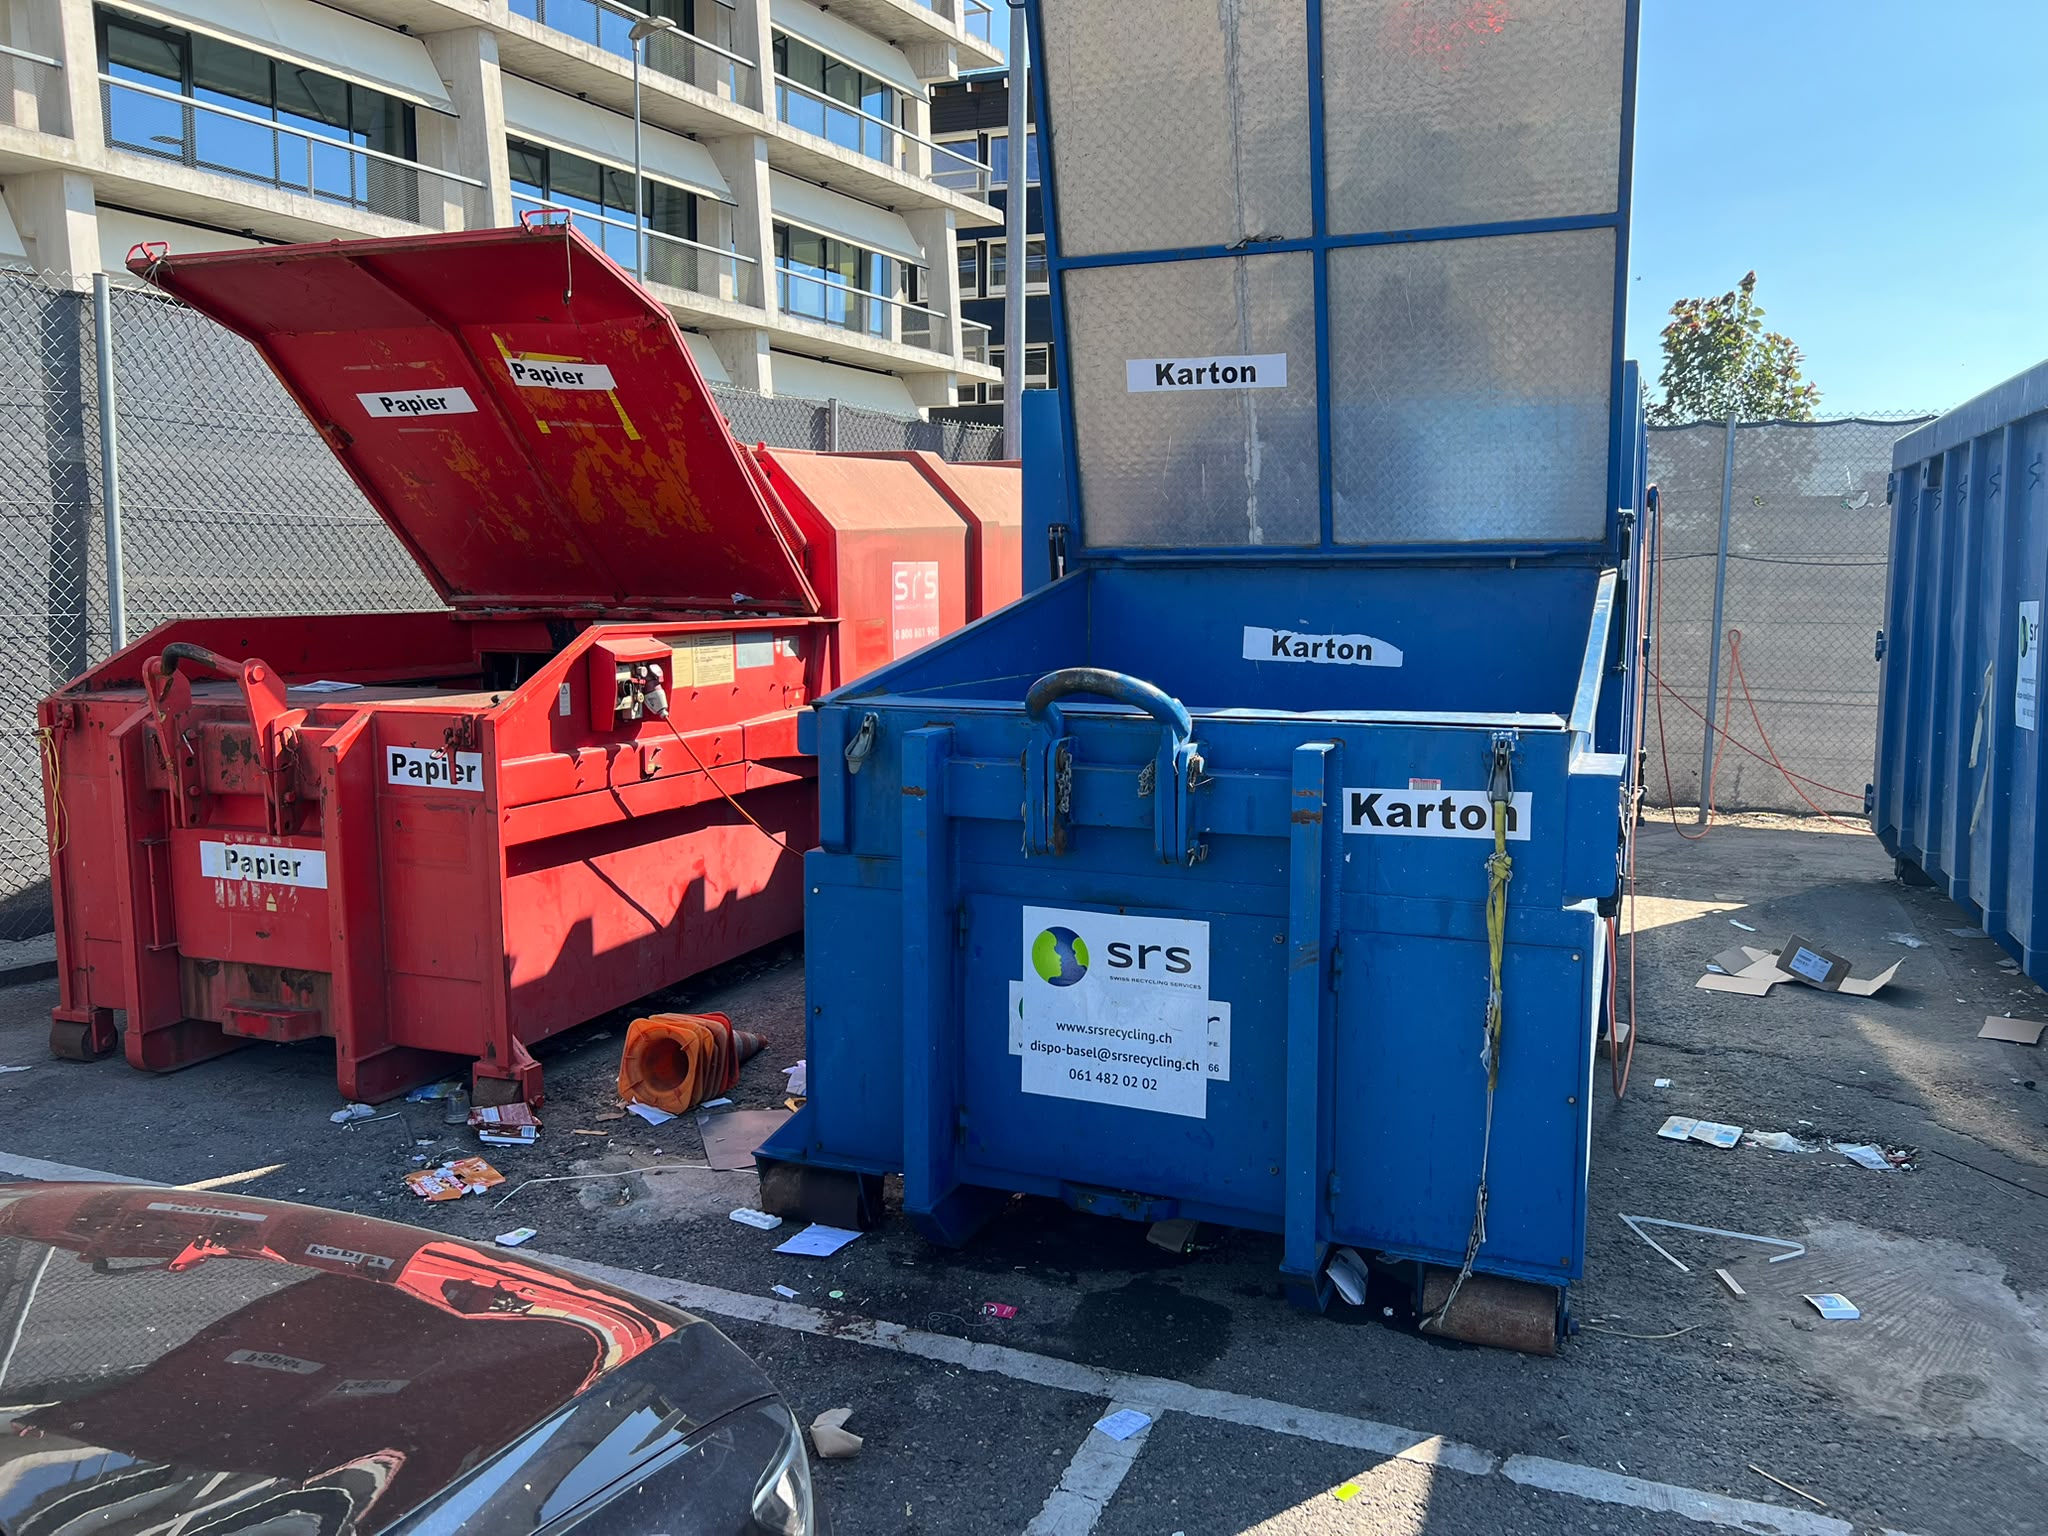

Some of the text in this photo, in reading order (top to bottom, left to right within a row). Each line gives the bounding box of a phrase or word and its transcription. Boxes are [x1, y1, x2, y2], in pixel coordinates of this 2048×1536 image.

[510, 362, 585, 386] Papier
[1155, 361, 1257, 386] Karton
[379, 395, 449, 416] Papier
[895, 570, 937, 600] srs
[1271, 634, 1373, 661] Karton
[391, 752, 477, 785] Papier
[1350, 792, 1518, 832] Karton
[224, 849, 302, 879] Papier
[1107, 942, 1192, 974] srs
[1131, 977, 1168, 986] RECYCLING
[1170, 981, 1202, 990] SERVICES
[1056, 1021, 1173, 1044] www.srsrecycling.ch
[1030, 1040, 1200, 1072] dispo-basel@srsrecycling.ch
[1069, 1068, 1158, 1091] 061 482 02 02
